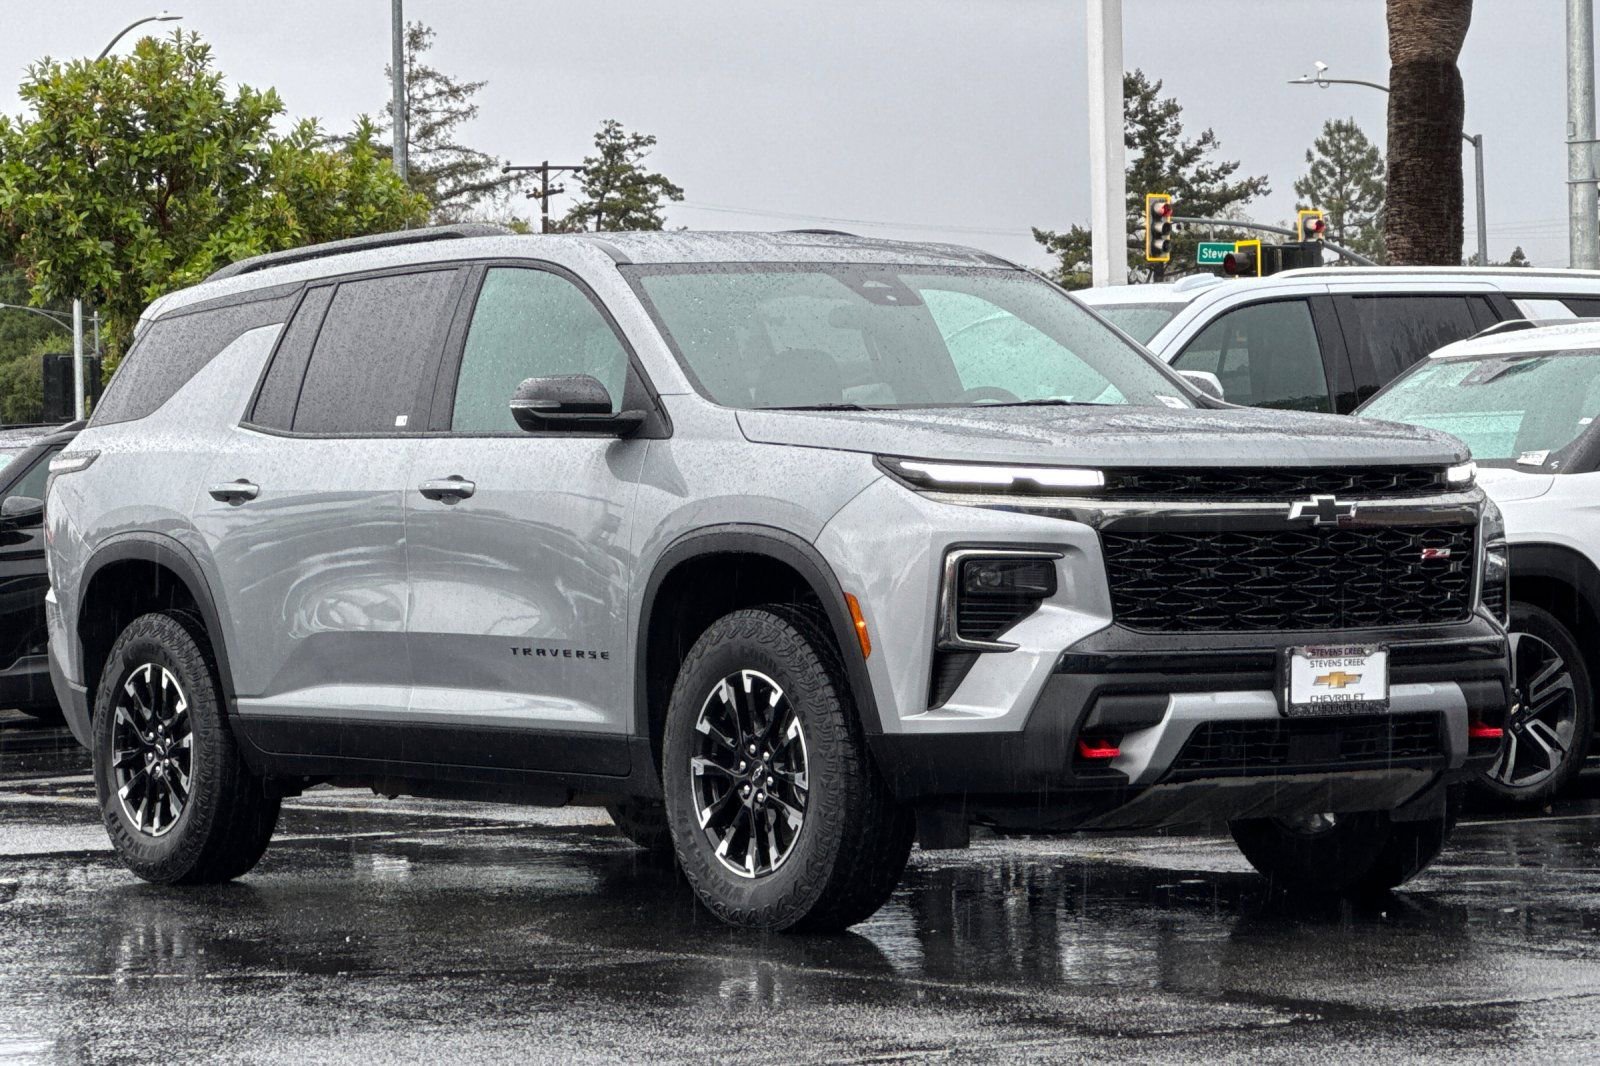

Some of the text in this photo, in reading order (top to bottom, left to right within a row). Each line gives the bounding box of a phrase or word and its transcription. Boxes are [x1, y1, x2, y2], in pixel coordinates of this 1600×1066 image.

[510, 647, 610, 660] TRAVERSE
[1311, 646, 1365, 656] STEVENS CREEK
[1310, 658, 1365, 668] STEVENS CREEK
